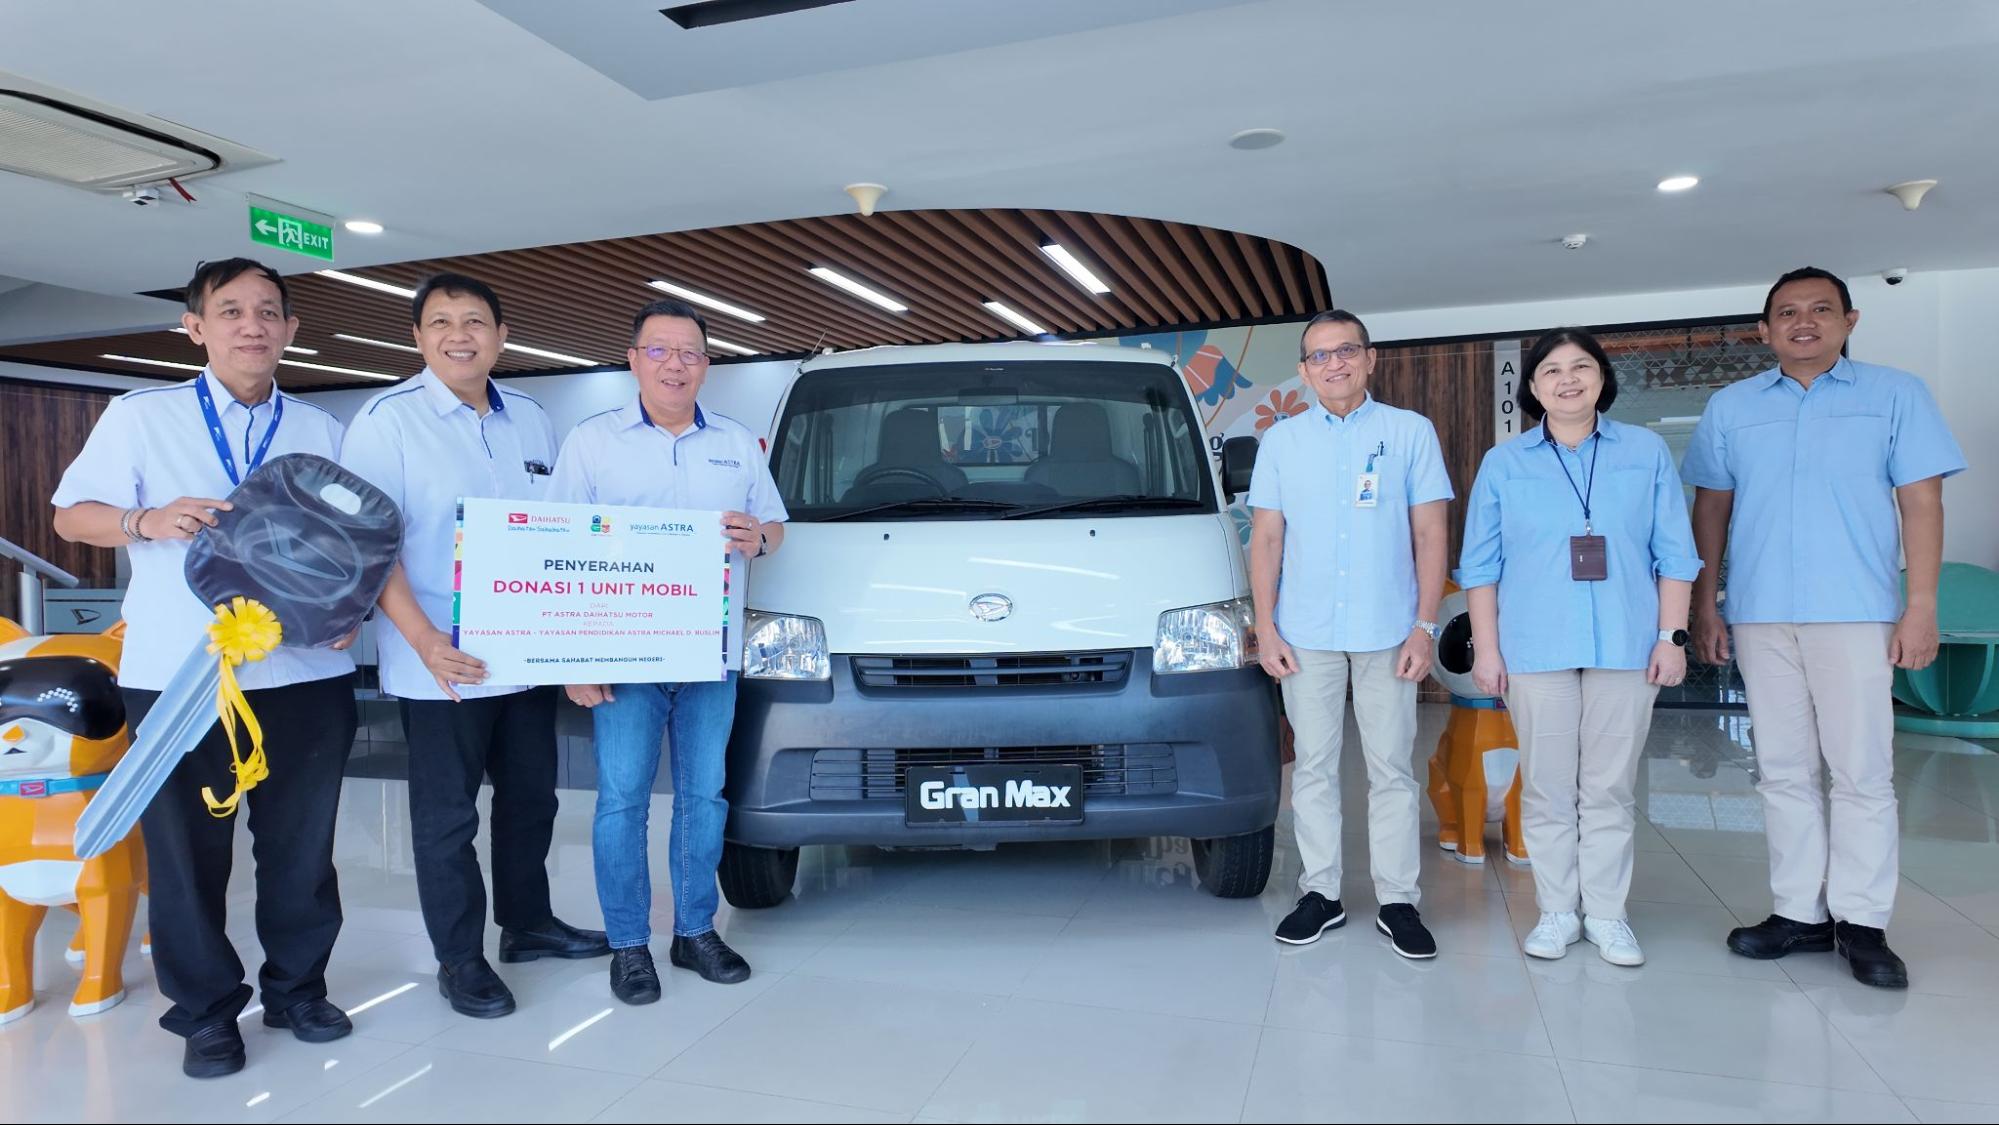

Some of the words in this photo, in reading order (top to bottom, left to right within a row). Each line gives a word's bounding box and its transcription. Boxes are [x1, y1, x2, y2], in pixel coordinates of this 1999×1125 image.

[303, 232, 329, 250] EXIT
[1501, 361, 1515, 433] A101
[531, 515, 571, 524] DAIHATSU
[630, 523, 659, 532] yayasan
[660, 523, 694, 533] ASTRA
[544, 559, 655, 573] PENYERAHAN
[493, 580, 571, 594] DONASI
[578, 581, 585, 595] 1
[591, 582, 635, 596] UNIT
[641, 583, 698, 597] MOBIL
[920, 780, 999, 810] Gran
[1005, 779, 1072, 808] Max
